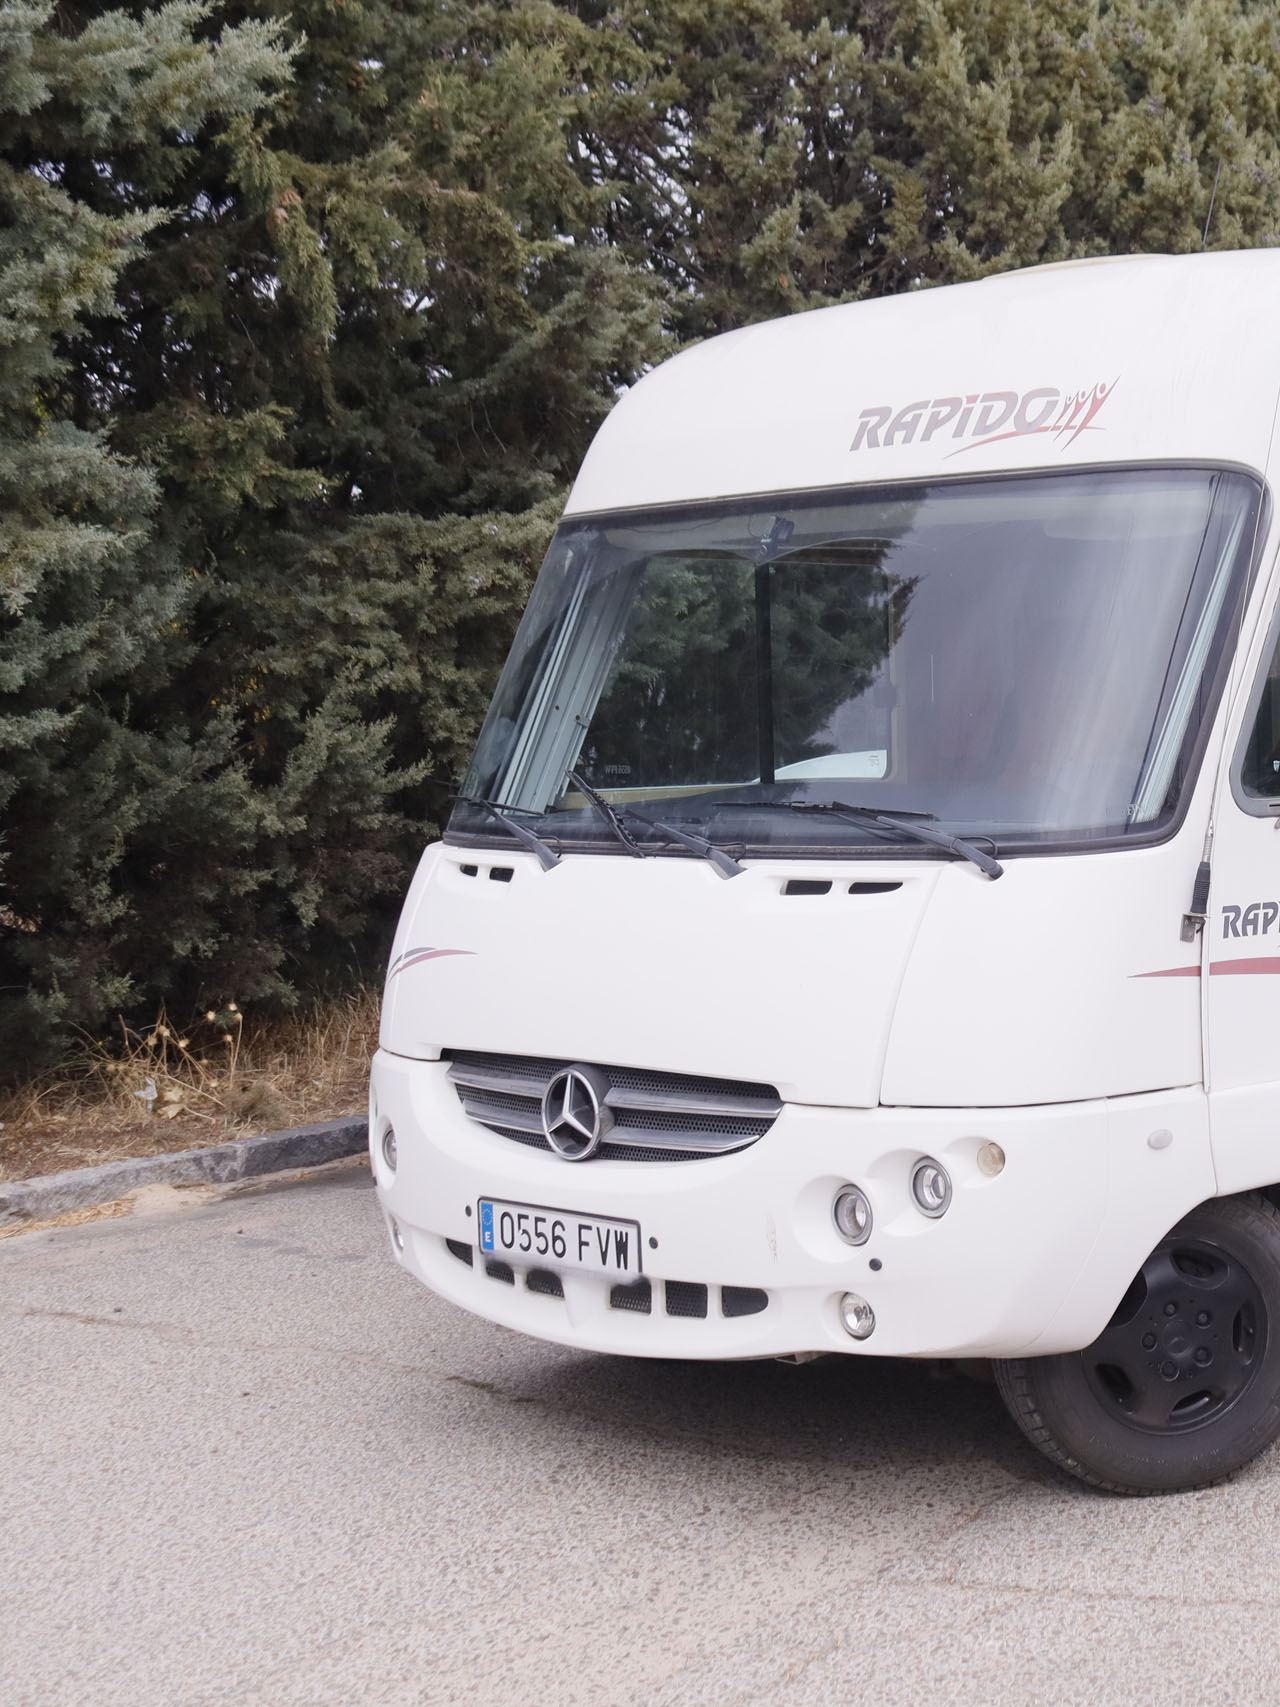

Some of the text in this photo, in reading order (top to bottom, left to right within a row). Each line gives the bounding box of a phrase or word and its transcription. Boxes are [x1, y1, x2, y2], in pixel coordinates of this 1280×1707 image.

[484, 1211, 629, 1271] E 0556 FVW
